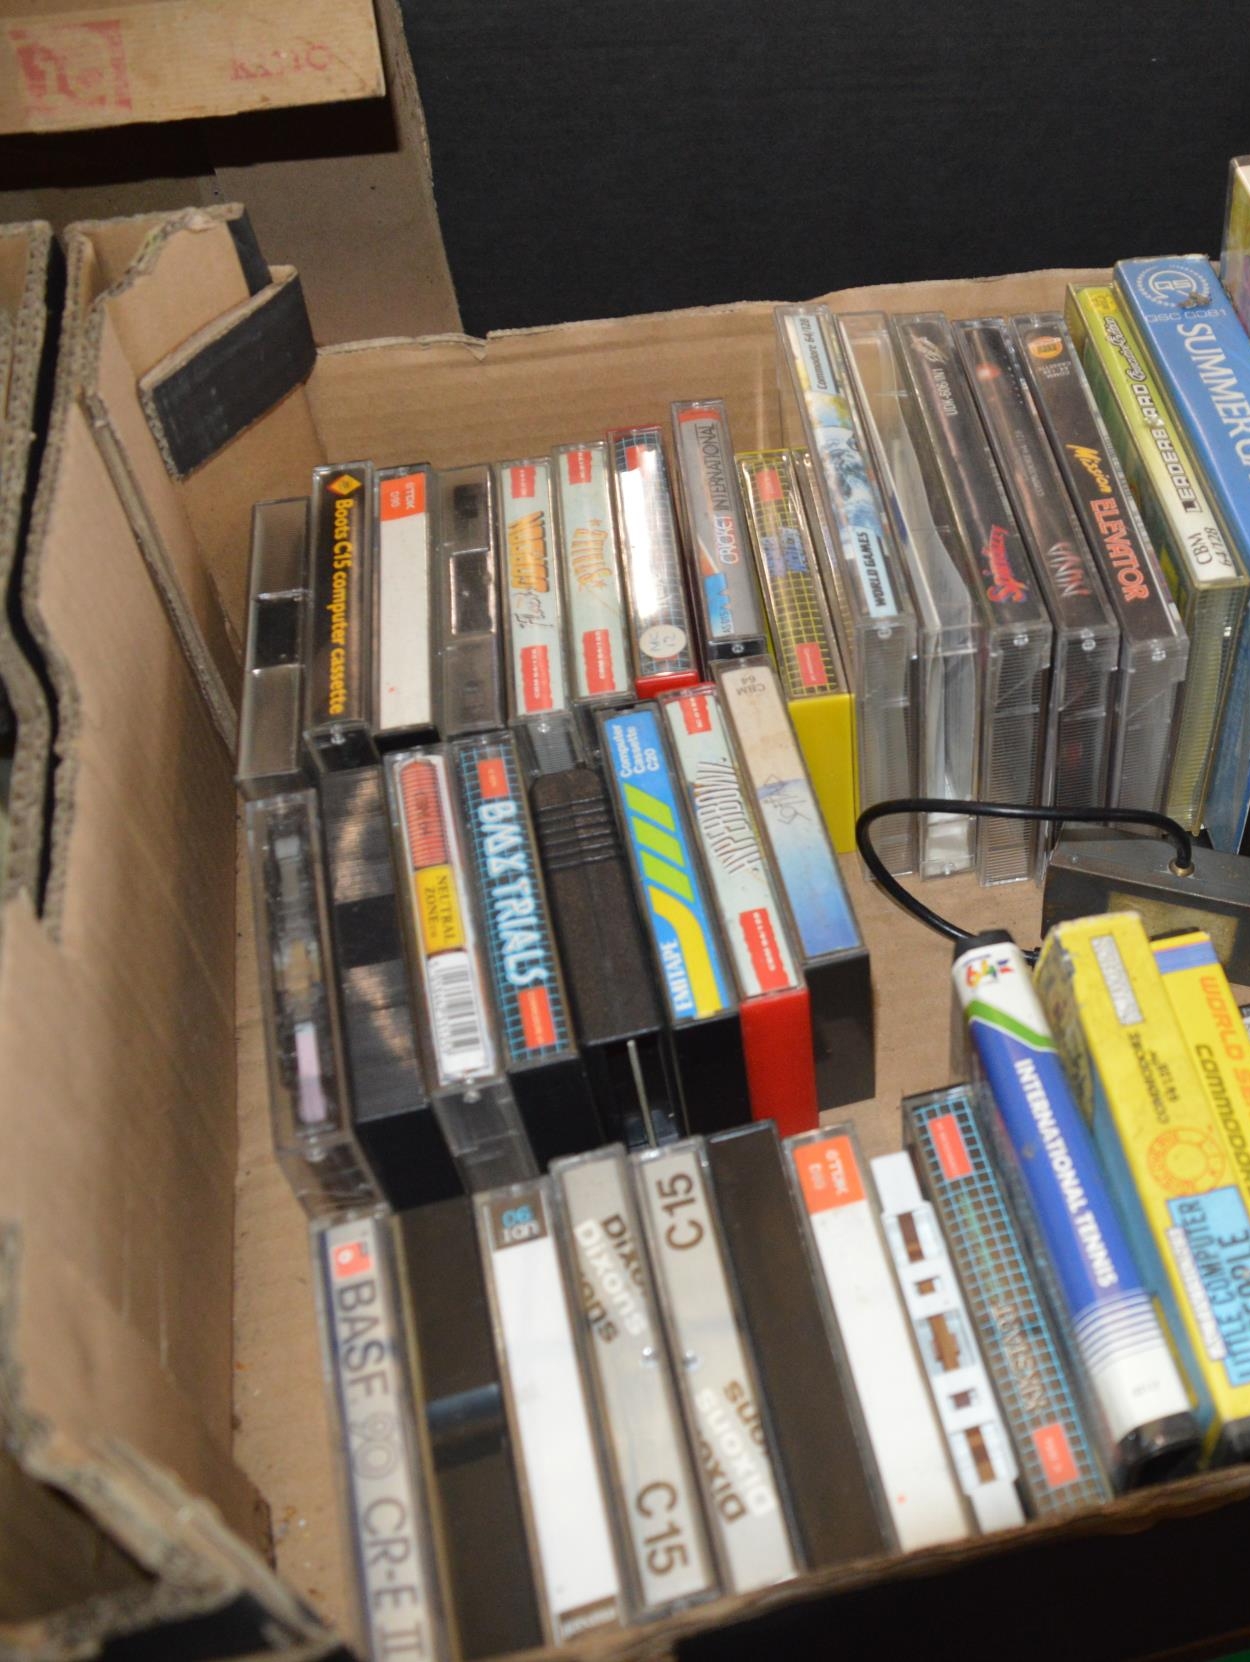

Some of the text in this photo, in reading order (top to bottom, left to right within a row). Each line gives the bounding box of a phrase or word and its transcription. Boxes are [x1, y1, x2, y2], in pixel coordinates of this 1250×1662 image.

[802, 317, 830, 392] Commodore 64/128
[1130, 383, 1204, 514] LEADERBOARD
[697, 422, 741, 565] CRICKET INTERNATIONAL
[1065, 443, 1150, 602] Mission ELEVATOR
[856, 530, 889, 608] WORLD GAMES
[1049, 542, 1090, 597] NINJA
[1188, 531, 1213, 566] CBM
[326, 498, 354, 715] Boots C15 computer cassette
[735, 682, 767, 697] CBM
[740, 673, 757, 685] 64
[611, 724, 633, 779] Computer
[631, 726, 649, 775] Cassette
[644, 747, 661, 773] C20
[477, 800, 528, 879] BMX
[693, 760, 762, 875] HYPERBOWL
[424, 886, 438, 927] ZONE
[437, 874, 458, 941] NEUTRAL
[494, 879, 548, 987] TRIALS
[660, 936, 692, 1013] EMITAPE
[1200, 976, 1245, 1062] WORLD
[656, 1170, 707, 1252] C15
[1013, 1057, 1120, 1290] INTERNATIONAL TENNIS
[574, 1218, 649, 1338] Dixons
[1178, 1200, 1238, 1303] COMPUTER
[337, 1276, 391, 1400] BASF
[364, 1496, 418, 1614] CR-E
[696, 1387, 777, 1519] Dixons
[635, 1480, 690, 1579] C15
